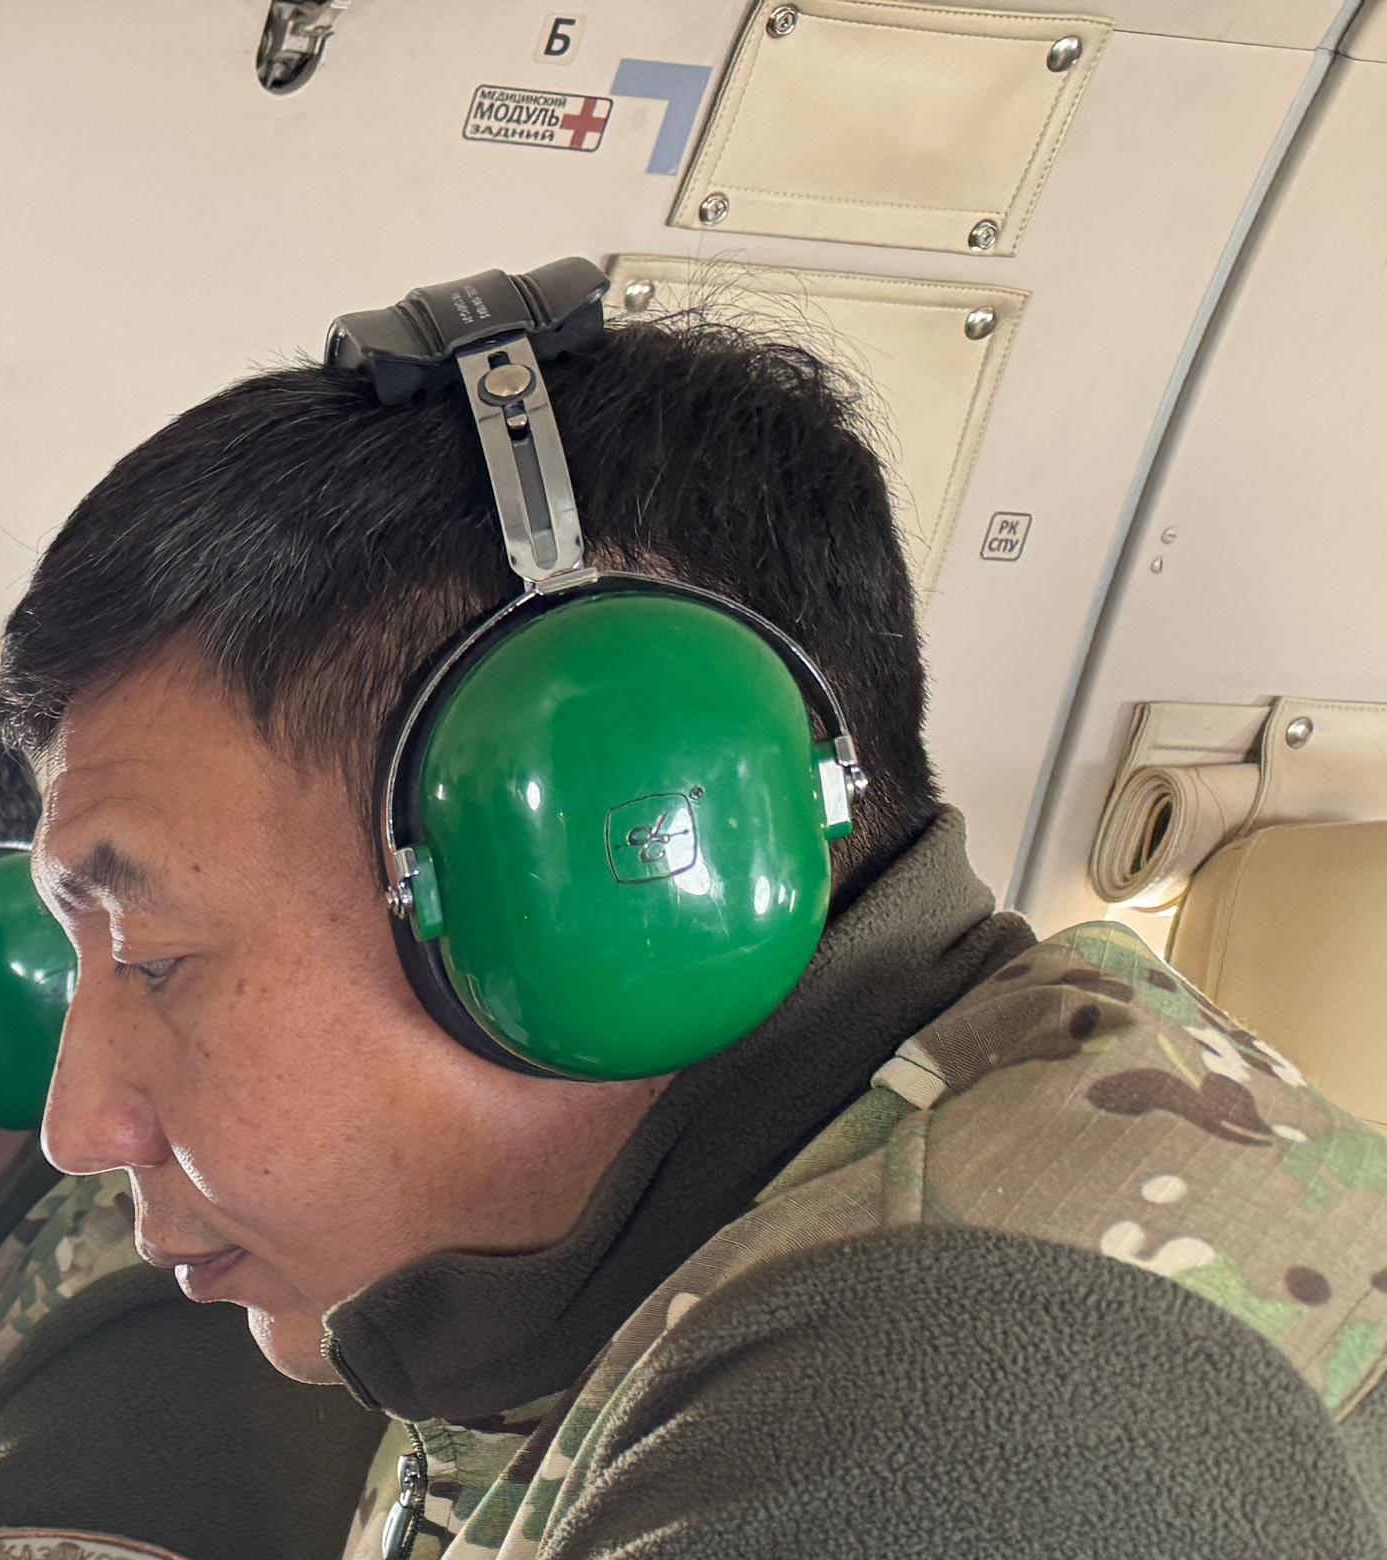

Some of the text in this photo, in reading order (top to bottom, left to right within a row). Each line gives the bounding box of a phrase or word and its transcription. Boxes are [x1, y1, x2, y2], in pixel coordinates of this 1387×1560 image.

[544, 17, 576, 56] Б
[478, 89, 567, 110] МЕДИЦИНСКИЙ
[472, 102, 560, 127] МОДУЛЬ
[469, 124, 555, 142] ЗАДНИЙ
[998, 520, 1019, 536] РК
[988, 537, 1019, 553] СПУ
